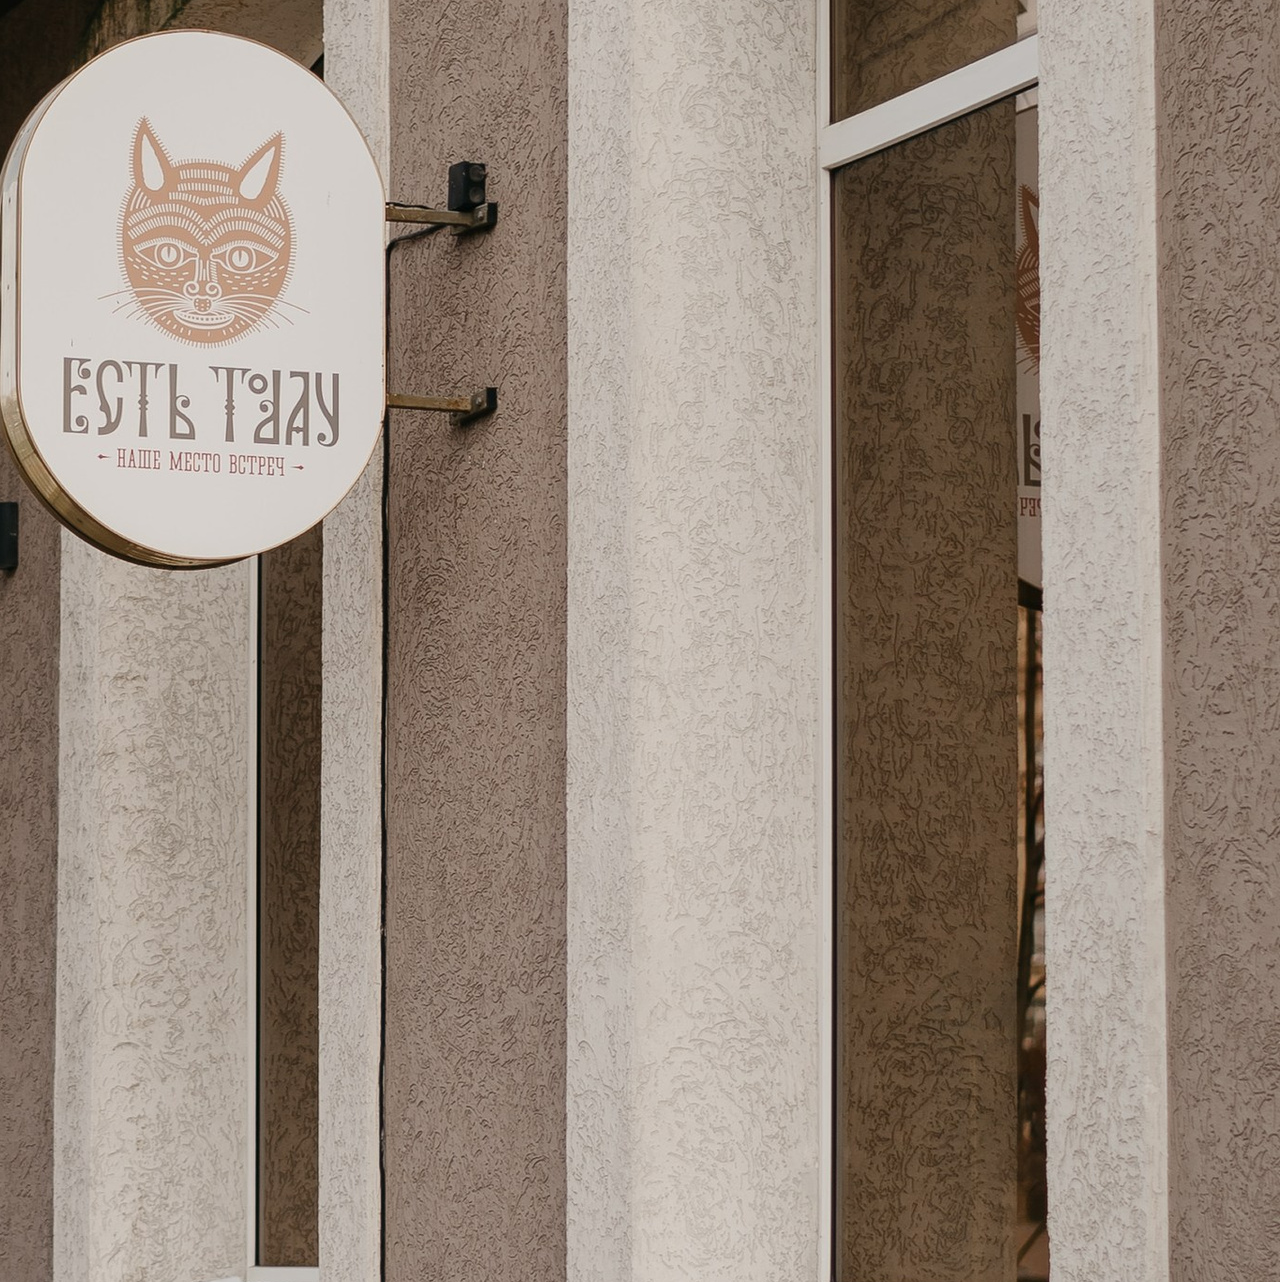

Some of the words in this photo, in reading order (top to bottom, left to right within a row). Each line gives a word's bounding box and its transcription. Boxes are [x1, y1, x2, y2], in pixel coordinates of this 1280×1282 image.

[63, 356, 196, 441] ЕСТЬ
[116, 447, 161, 470] НАШЕ
[169, 450, 221, 474] МЕСТО
[228, 453, 285, 477] ВСТРЕЧ
